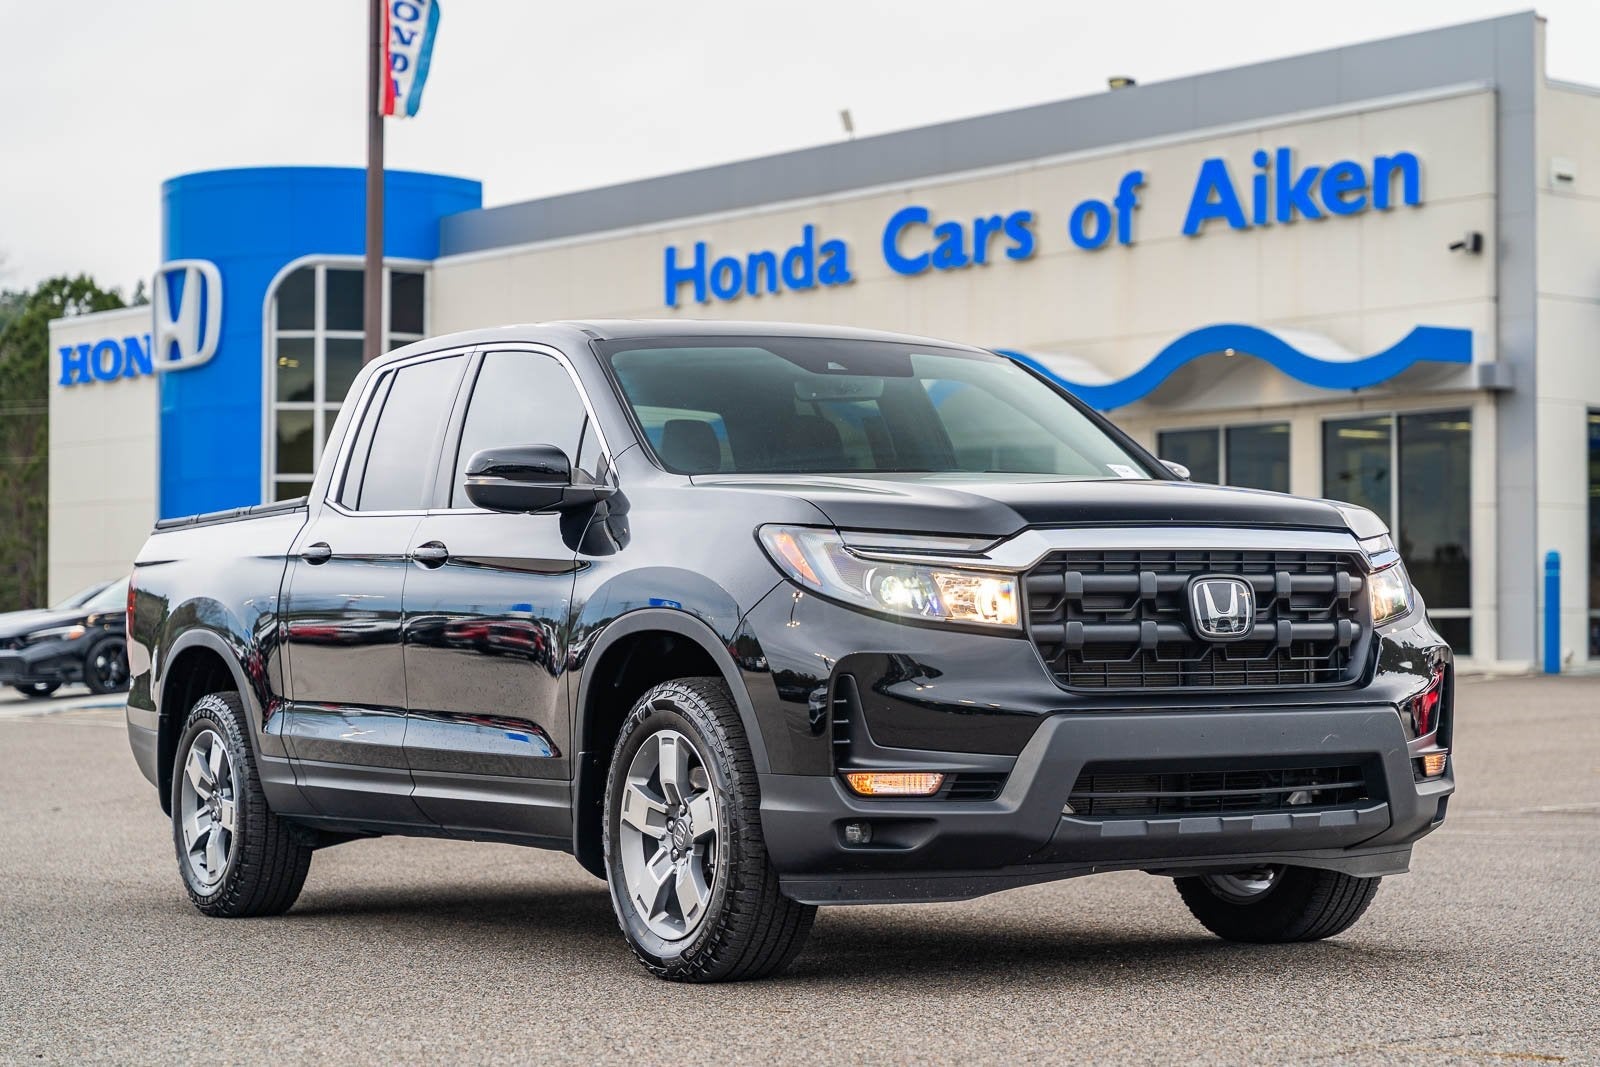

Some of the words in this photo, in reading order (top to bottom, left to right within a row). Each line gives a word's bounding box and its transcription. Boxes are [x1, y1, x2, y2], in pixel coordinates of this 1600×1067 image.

[665, 224, 853, 308] Honda
[882, 206, 1036, 276] Cars
[1069, 170, 1145, 251] of
[1181, 146, 1421, 237] Aiken
